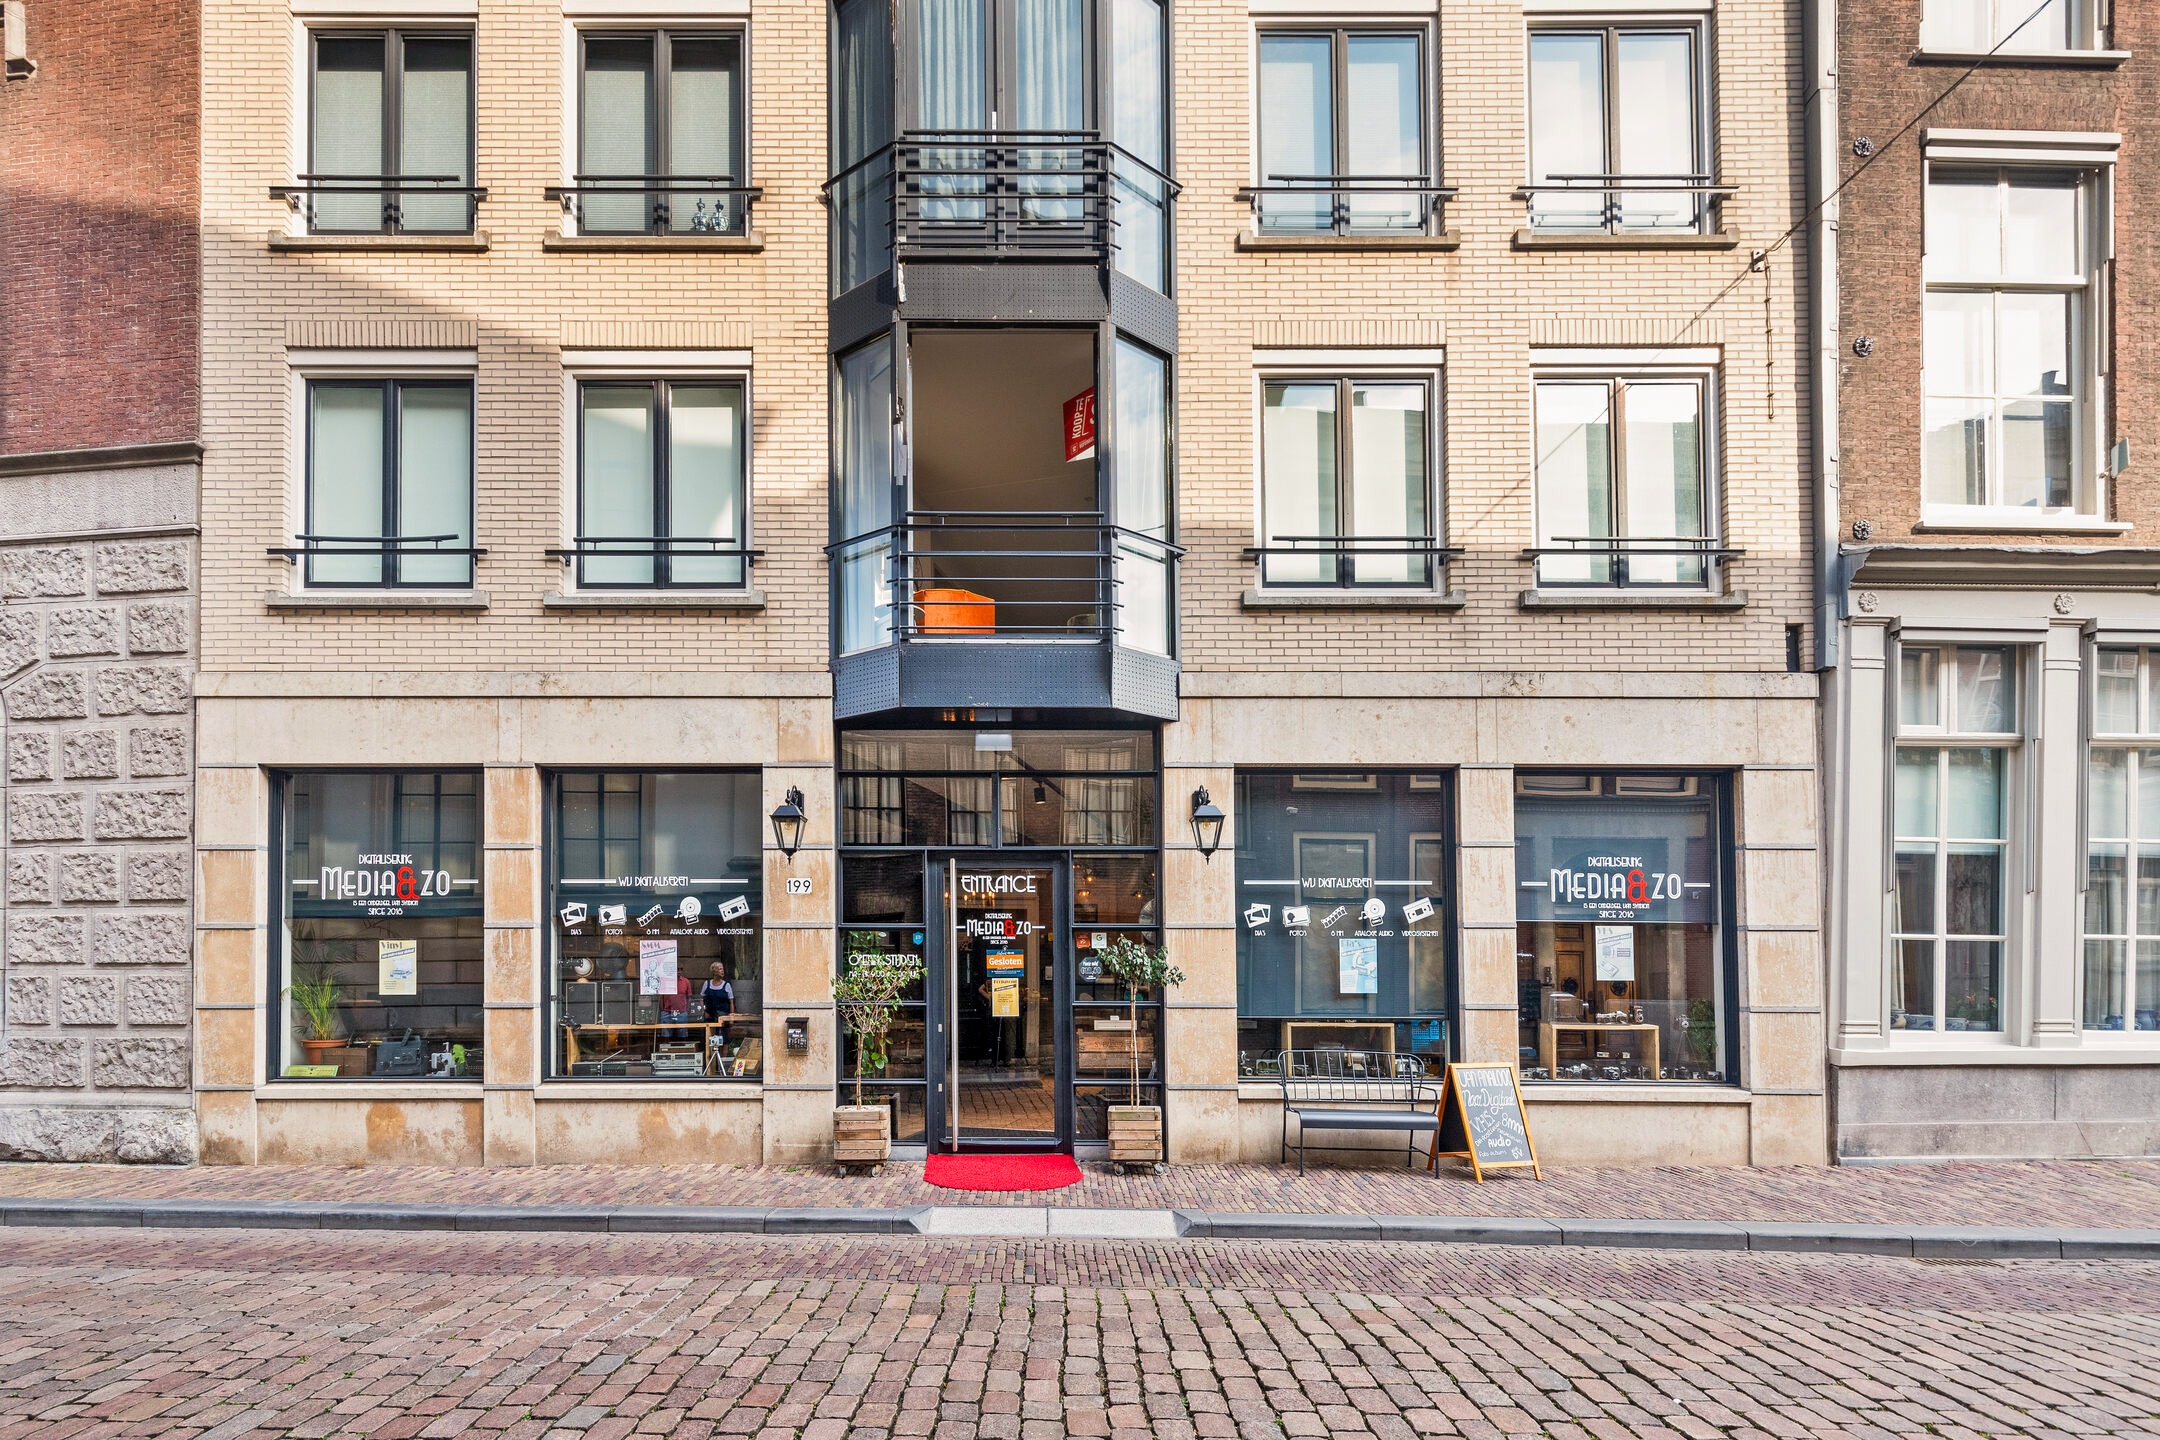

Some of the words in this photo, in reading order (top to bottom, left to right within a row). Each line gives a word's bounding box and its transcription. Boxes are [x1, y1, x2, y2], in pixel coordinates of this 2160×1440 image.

[1072, 412, 1083, 439] KOOP
[635, 876, 689, 887] DIGITALISEREN
[787, 879, 811, 893] 199
[961, 875, 1035, 893] ENTRANCE
[1318, 877, 1373, 888] DIGITALISEREN
[367, 907, 386, 915] SINCE
[1598, 910, 1617, 918] SINCE
[381, 941, 403, 949] Vinyl
[989, 957, 1022, 966] Gesloten
[1469, 1110, 1496, 1133] VHS
